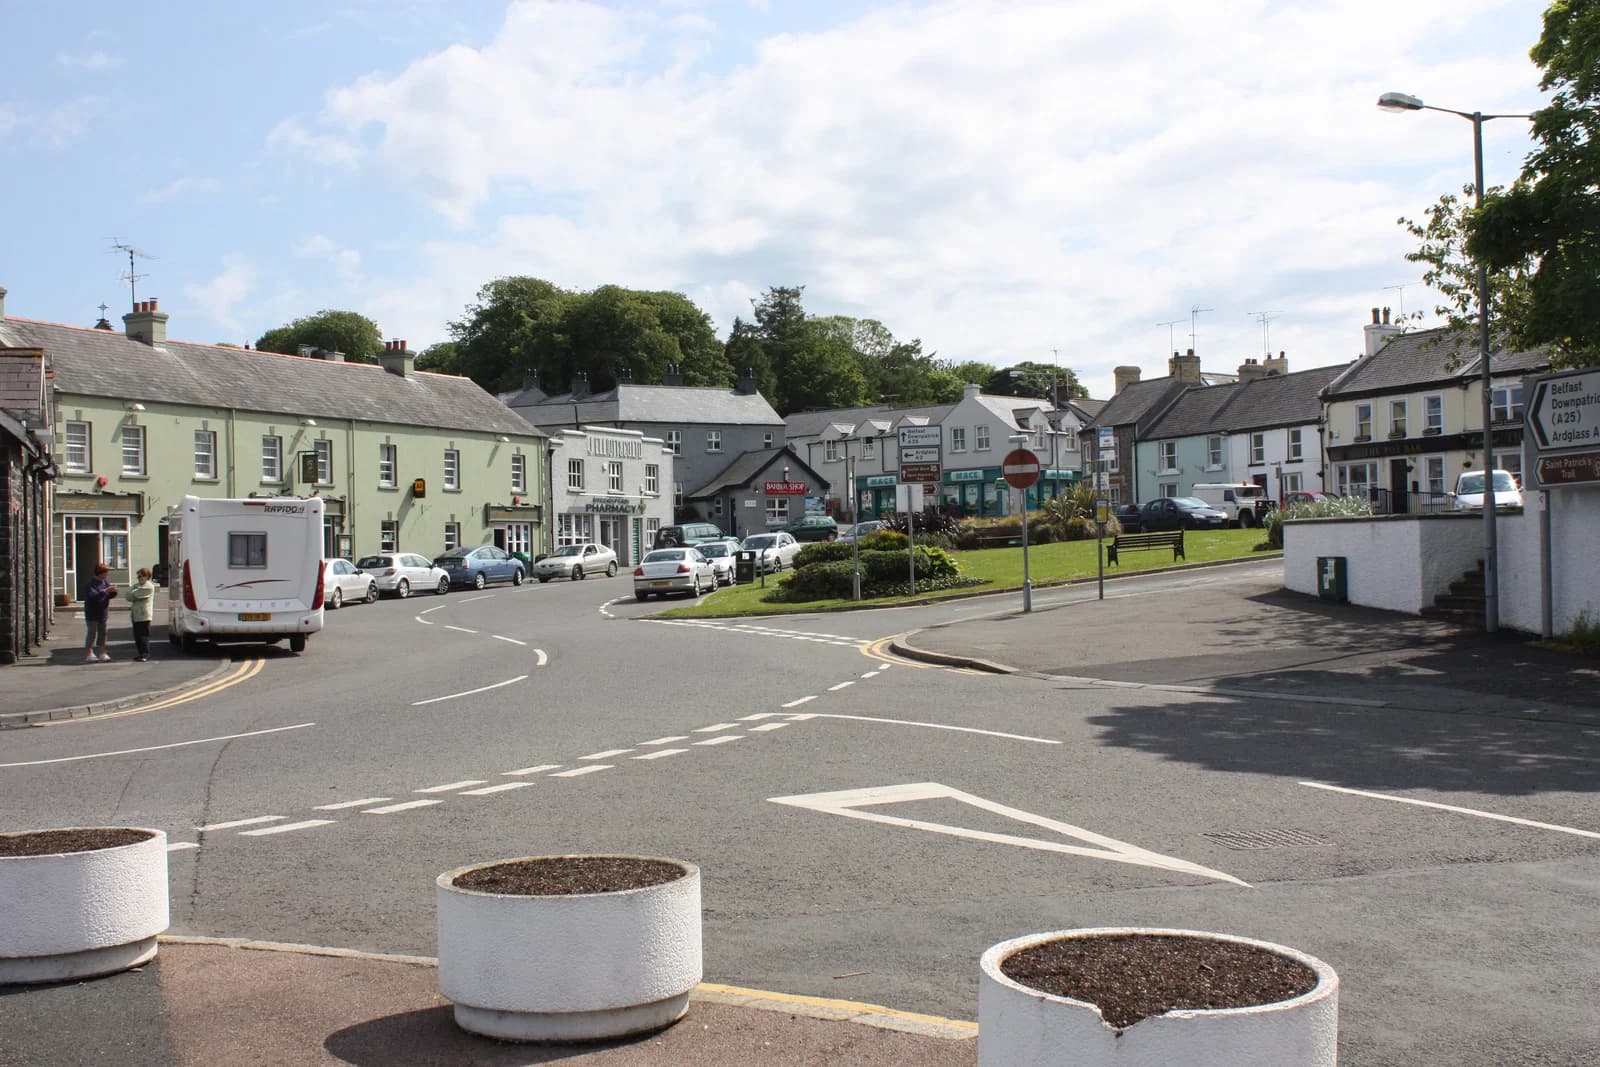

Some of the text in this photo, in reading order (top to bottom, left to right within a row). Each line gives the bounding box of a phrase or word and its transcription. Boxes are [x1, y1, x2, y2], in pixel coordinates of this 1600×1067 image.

[1551, 381, 1583, 395] Belfast
[1551, 410, 1581, 426] (A25)
[1552, 428, 1591, 442] Ardglass
[955, 471, 979, 479] MACE
[1560, 469, 1577, 479] Trail
[789, 483, 805, 491] SHOP
[264, 505, 298, 514] RAPIDO
[585, 503, 637, 513] PHARMACY
